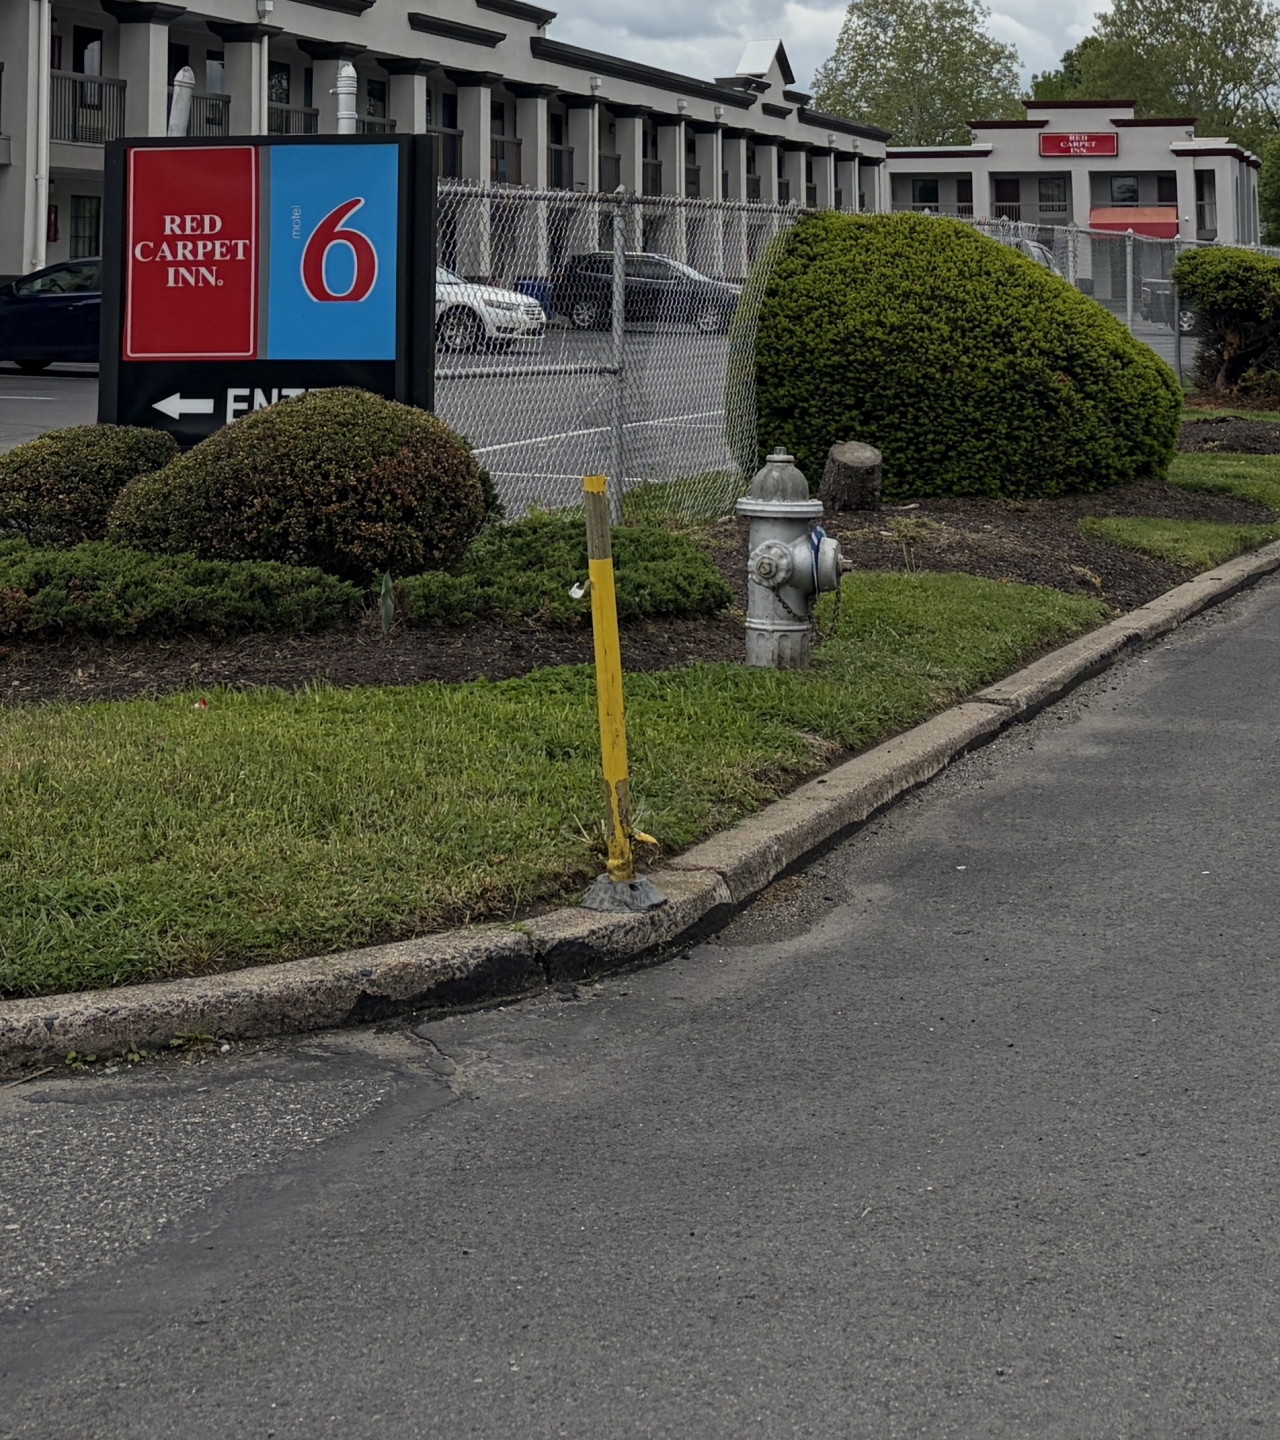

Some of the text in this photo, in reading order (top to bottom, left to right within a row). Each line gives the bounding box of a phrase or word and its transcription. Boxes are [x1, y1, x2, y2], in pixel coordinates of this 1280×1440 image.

[163, 214, 223, 235] RED
[291, 205, 302, 239] motel
[134, 239, 250, 262] CARPET
[300, 196, 379, 303] 6
